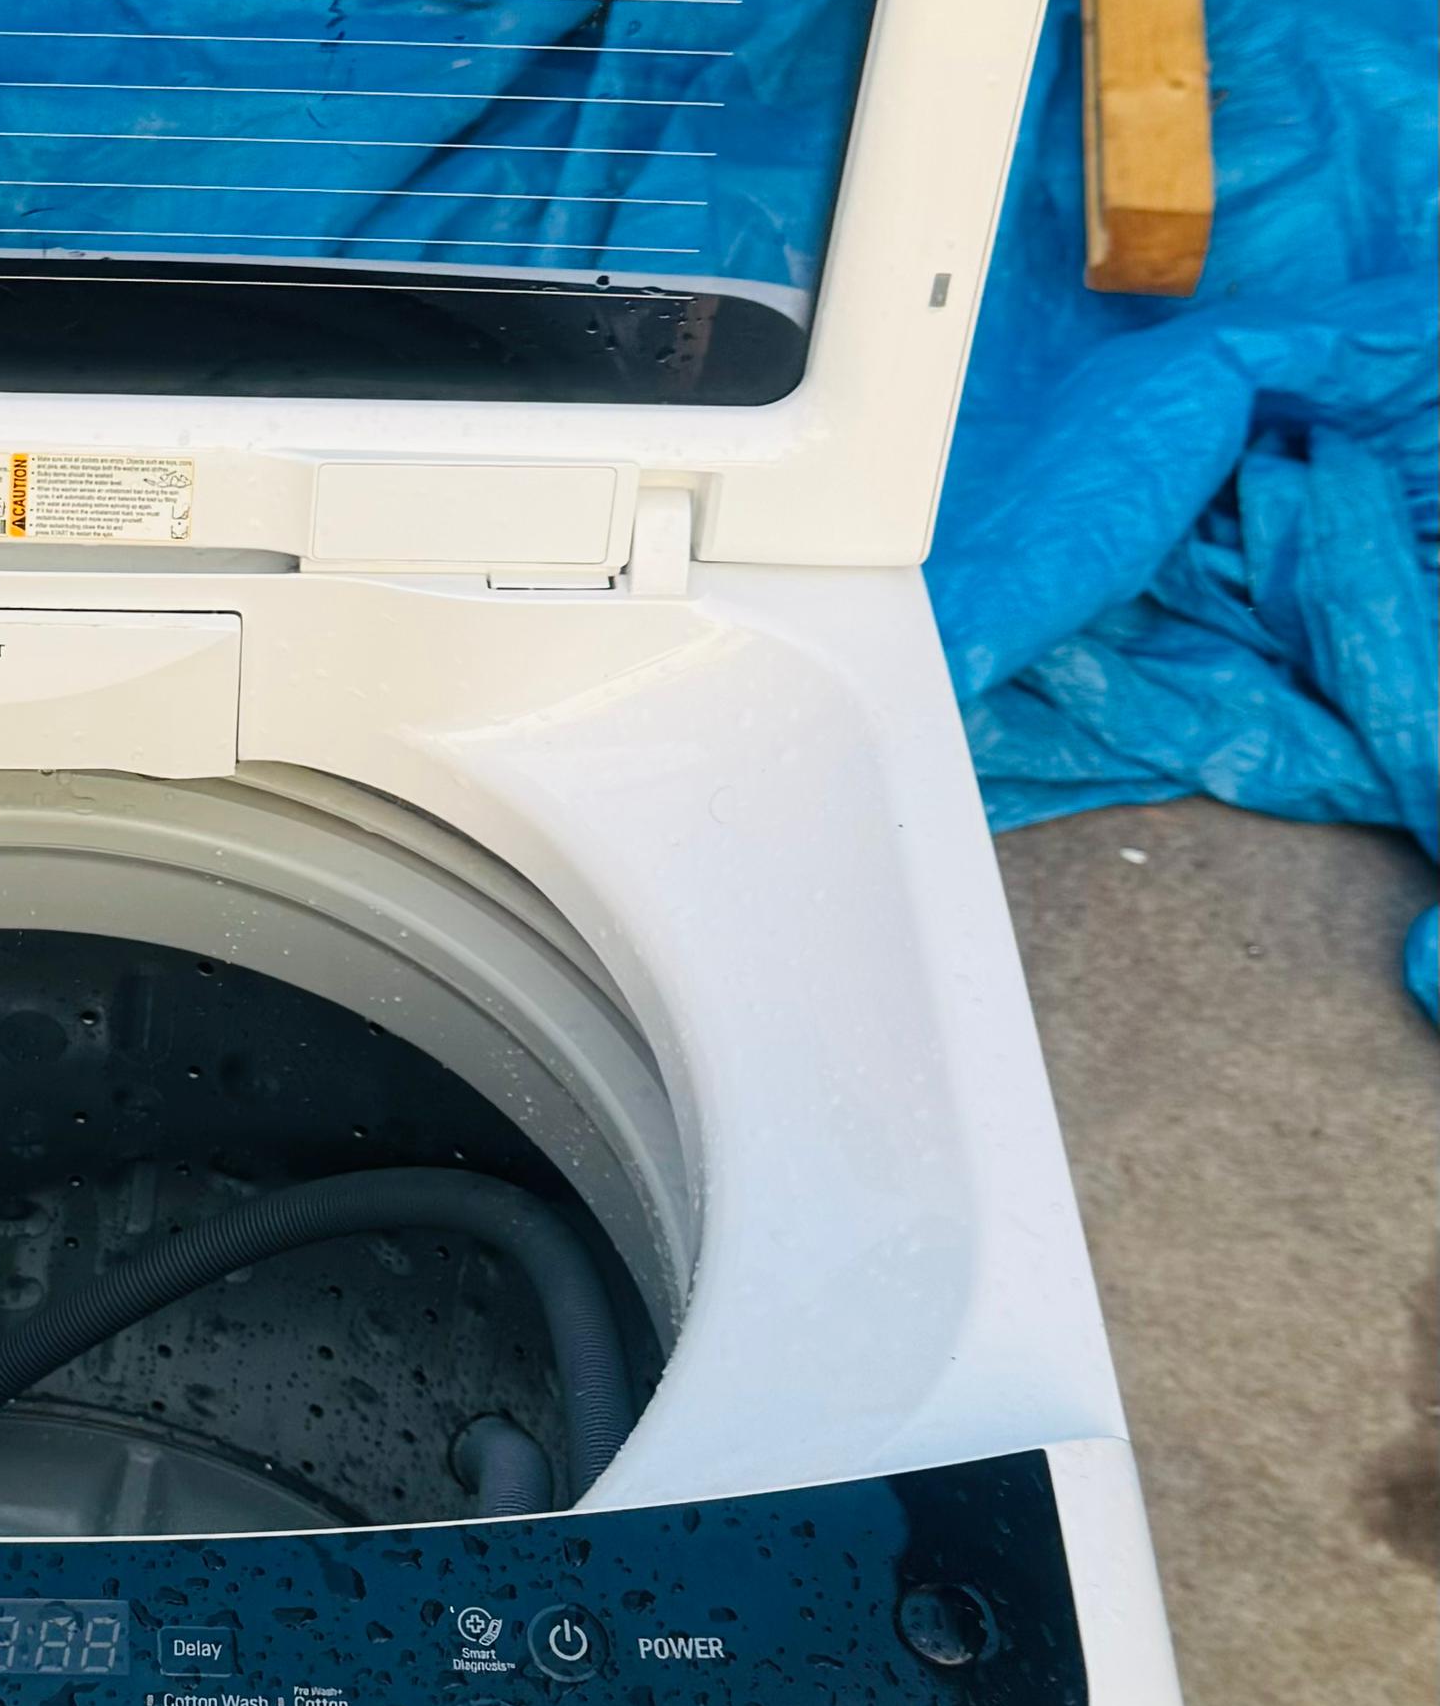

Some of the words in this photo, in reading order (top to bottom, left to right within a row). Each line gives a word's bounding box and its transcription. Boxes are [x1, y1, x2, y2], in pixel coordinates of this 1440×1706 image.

[12, 459, 27, 516] CAUTION
[173, 1640, 223, 1661] Delay
[462, 1647, 497, 1659] Smart
[638, 1637, 725, 1660] POWER
